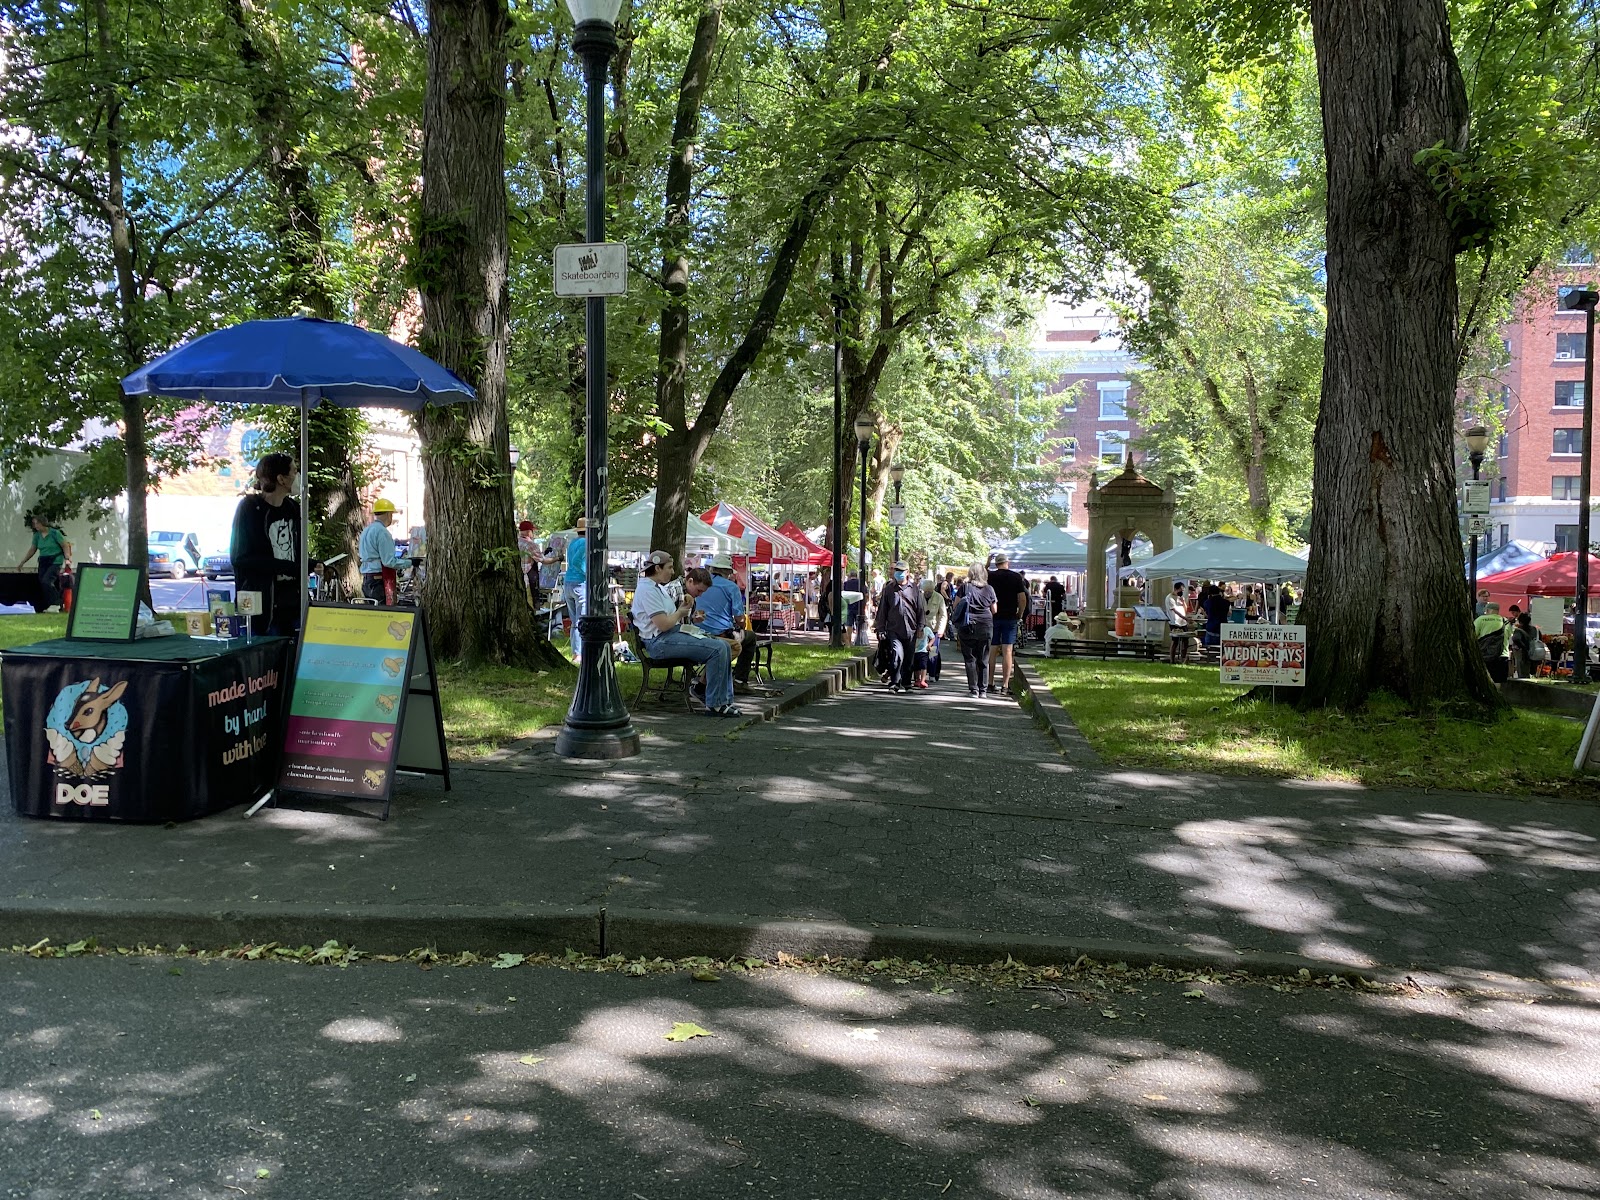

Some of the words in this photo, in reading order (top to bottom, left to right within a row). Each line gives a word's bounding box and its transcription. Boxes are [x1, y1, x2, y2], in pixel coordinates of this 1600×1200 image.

[561, 271, 620, 281] Skateboarding
[1229, 631, 1263, 640] FARMERS
[1224, 646, 1302, 662] WEDNESDAYS
[208, 680, 246, 707] made
[248, 669, 278, 694] locally
[224, 715, 240, 736] by
[223, 740, 253, 765] with
[55, 783, 110, 807] DOE
